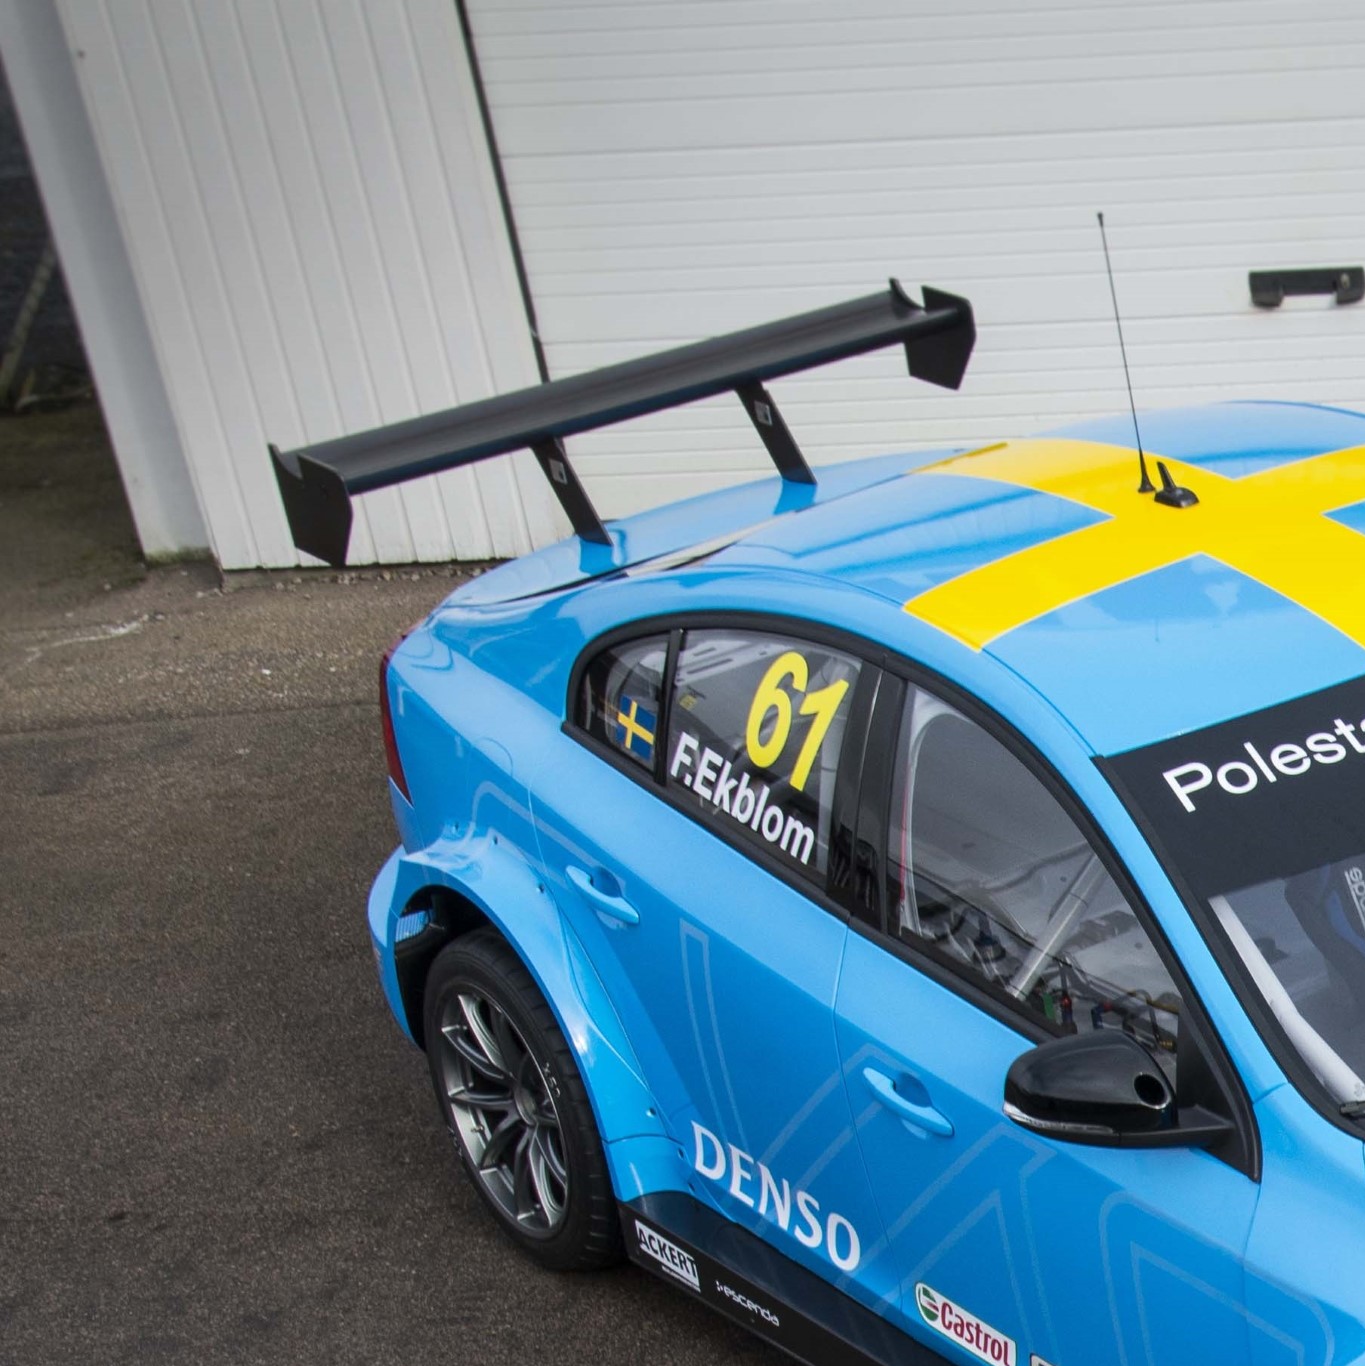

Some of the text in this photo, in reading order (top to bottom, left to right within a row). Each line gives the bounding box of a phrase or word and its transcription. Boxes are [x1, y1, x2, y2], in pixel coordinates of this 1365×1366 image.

[745, 651, 849, 792] 61
[670, 731, 816, 865] F.Ekblom
[638, 1227, 697, 1278] ACKERT
[691, 1120, 861, 1271] DENSO
